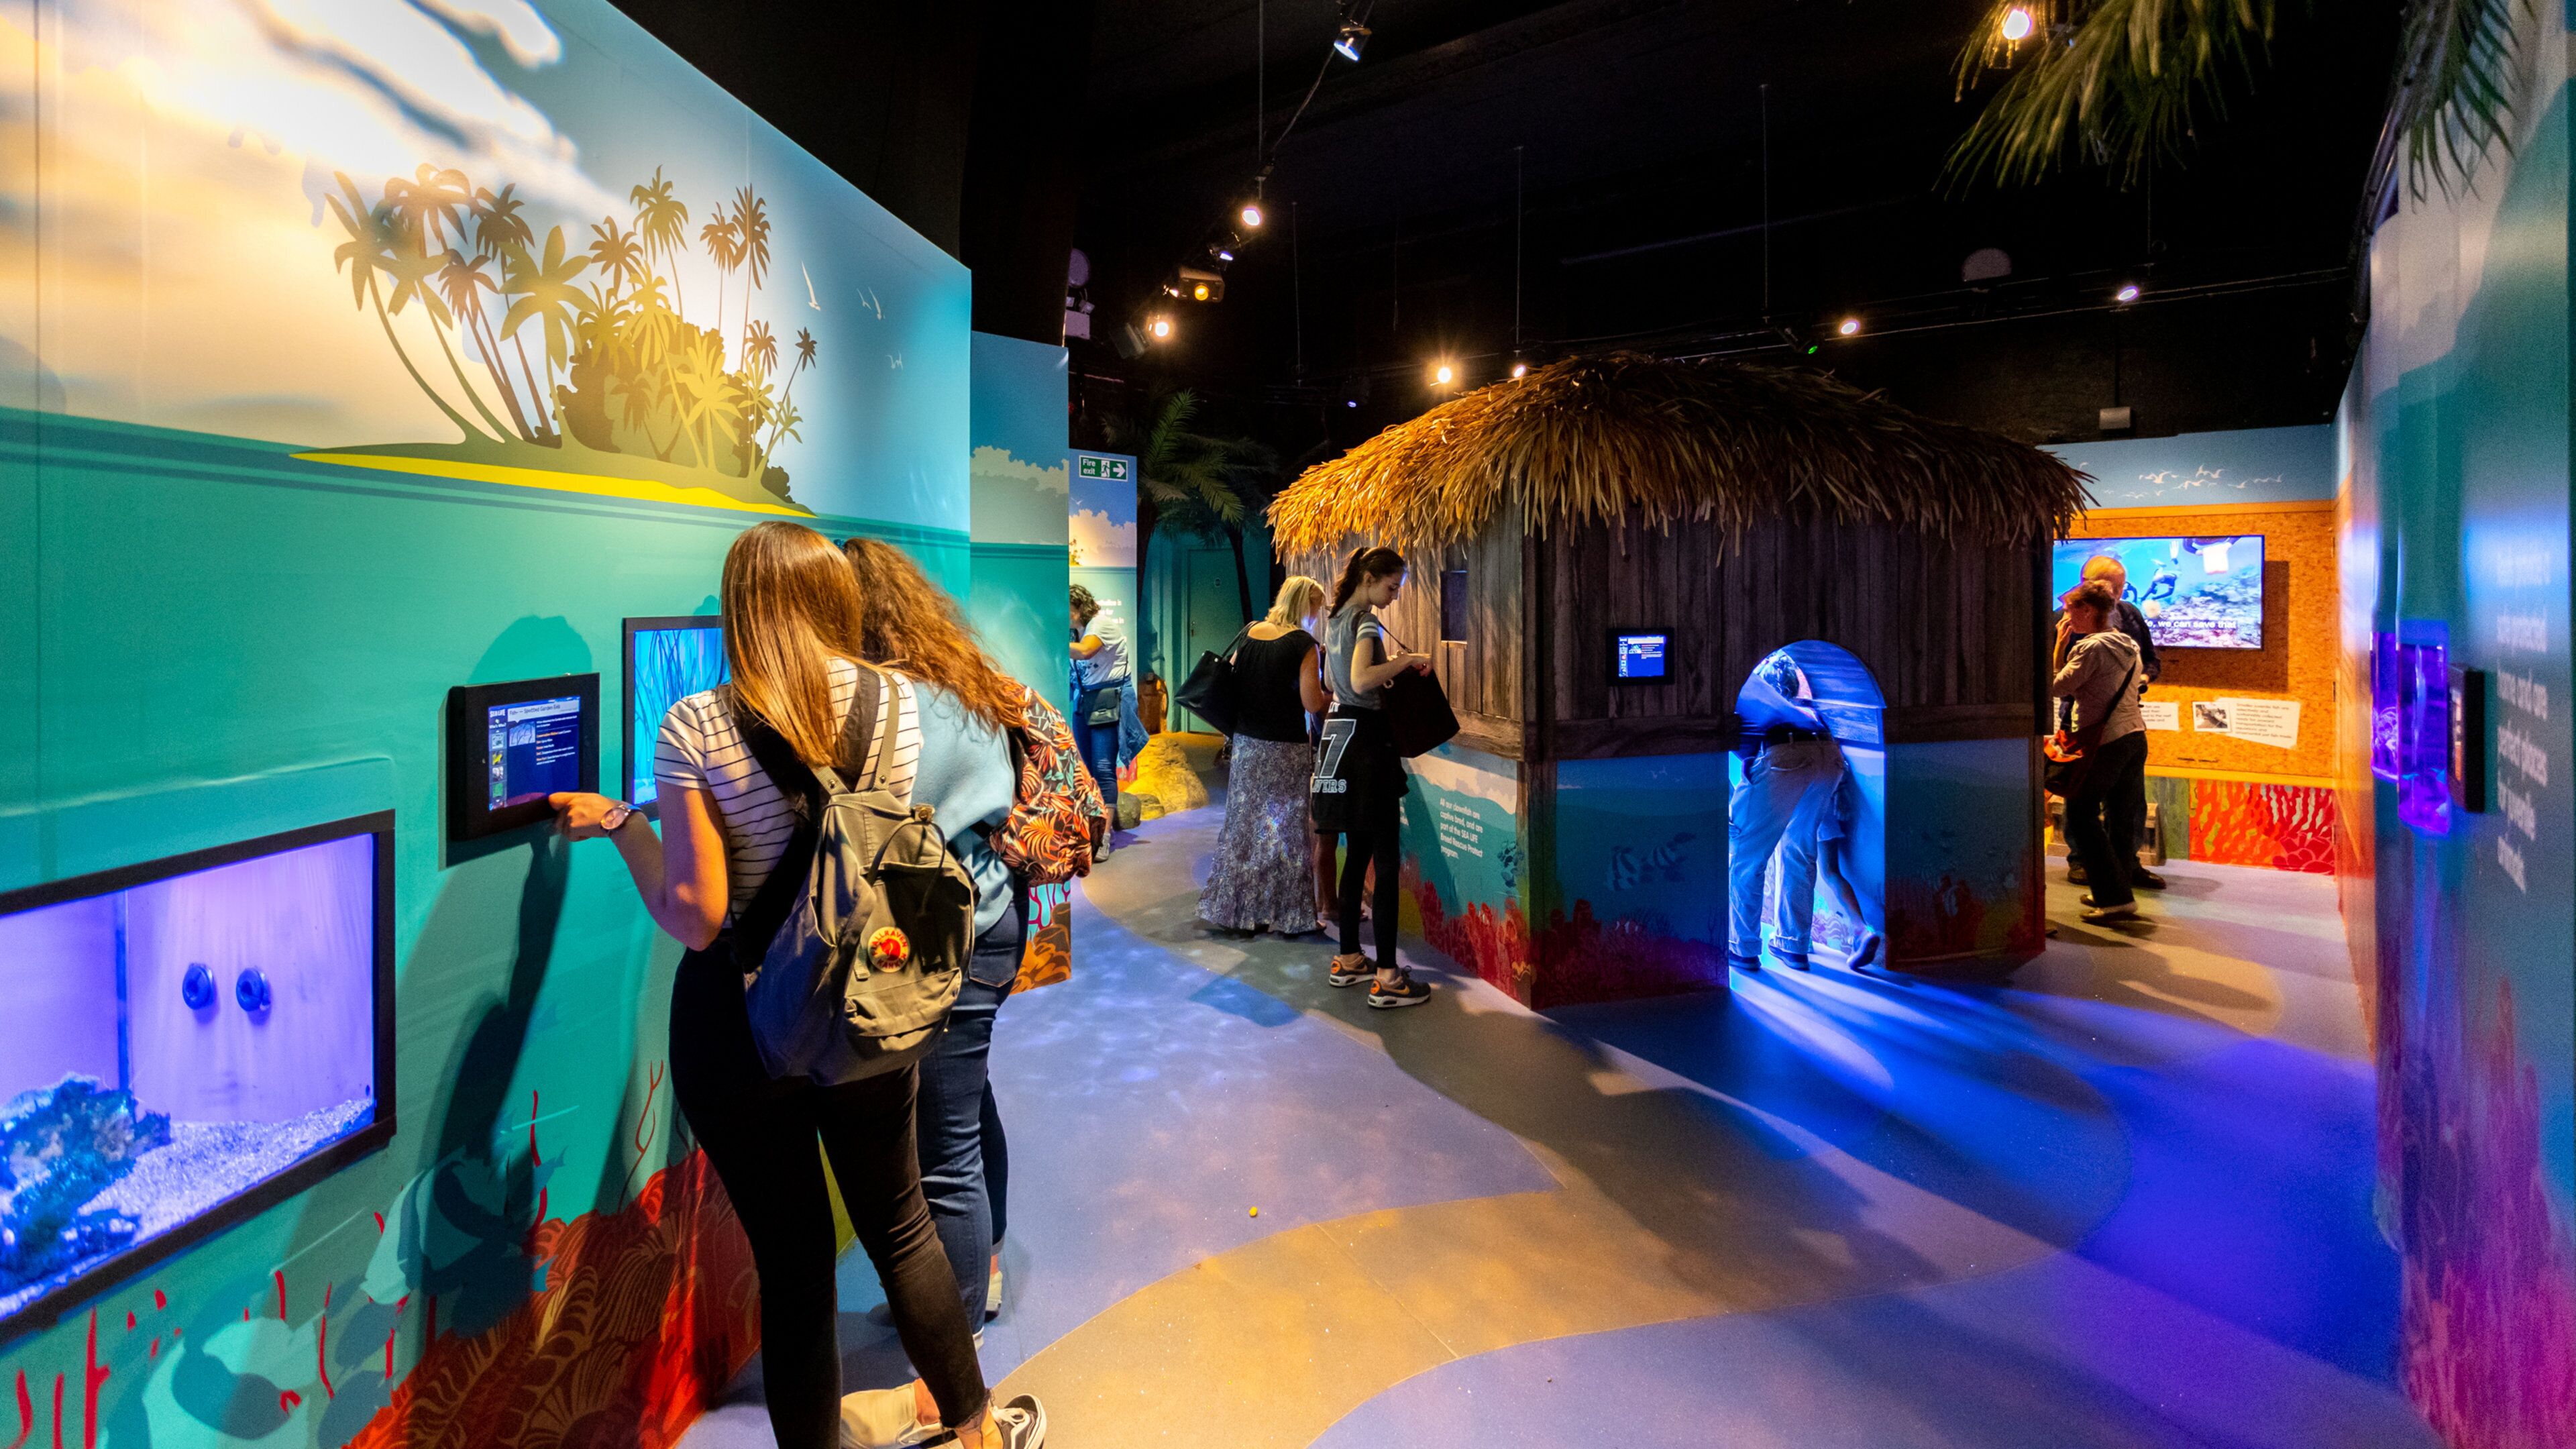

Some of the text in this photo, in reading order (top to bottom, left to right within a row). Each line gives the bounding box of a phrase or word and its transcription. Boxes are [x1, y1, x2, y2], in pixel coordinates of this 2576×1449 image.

[1083, 459, 1095, 467] Fire
[1440, 810, 1454, 822] captive
[1466, 820, 1474, 830] and
[1475, 824, 1483, 833] are
[1472, 811, 1481, 820] are
[1440, 822, 1479, 844] part of the SEA LIFE
[1440, 833, 1483, 858] Breed Rescue Protect
